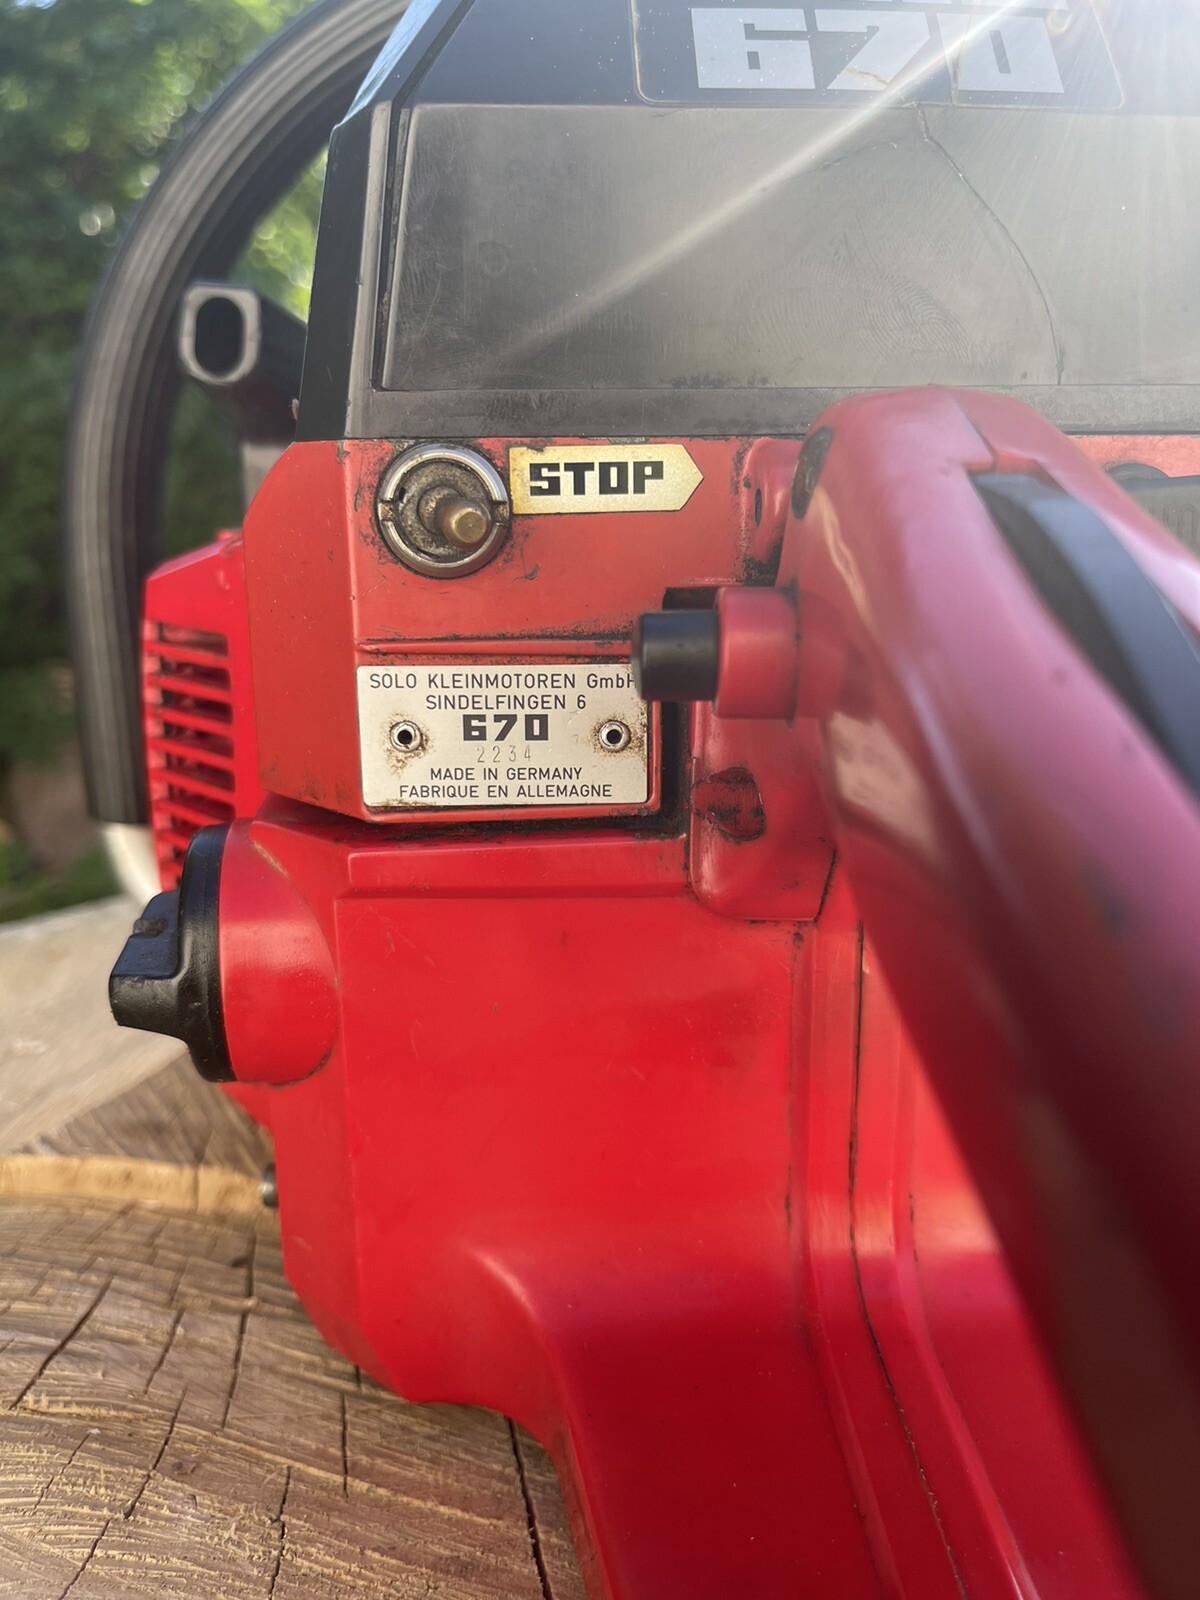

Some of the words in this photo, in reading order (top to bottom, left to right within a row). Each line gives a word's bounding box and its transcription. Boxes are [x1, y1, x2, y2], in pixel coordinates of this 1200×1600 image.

[691, 8, 1065, 93] 670
[529, 461, 664, 496] STOP
[370, 674, 417, 689] SOLO
[428, 673, 575, 688] KLEINMOTOREN
[426, 695, 566, 710] SINDELFINGEN
[576, 694, 587, 710] 6
[463, 714, 549, 741] 670
[476, 744, 532, 763] 2234
[430, 768, 474, 781] MADE
[483, 768, 497, 780] IN
[506, 767, 583, 780] GERMANY
[400, 785, 479, 798] FABRIQUE
[487, 785, 508, 798] EN
[516, 784, 612, 797] ALLEMAGNE
